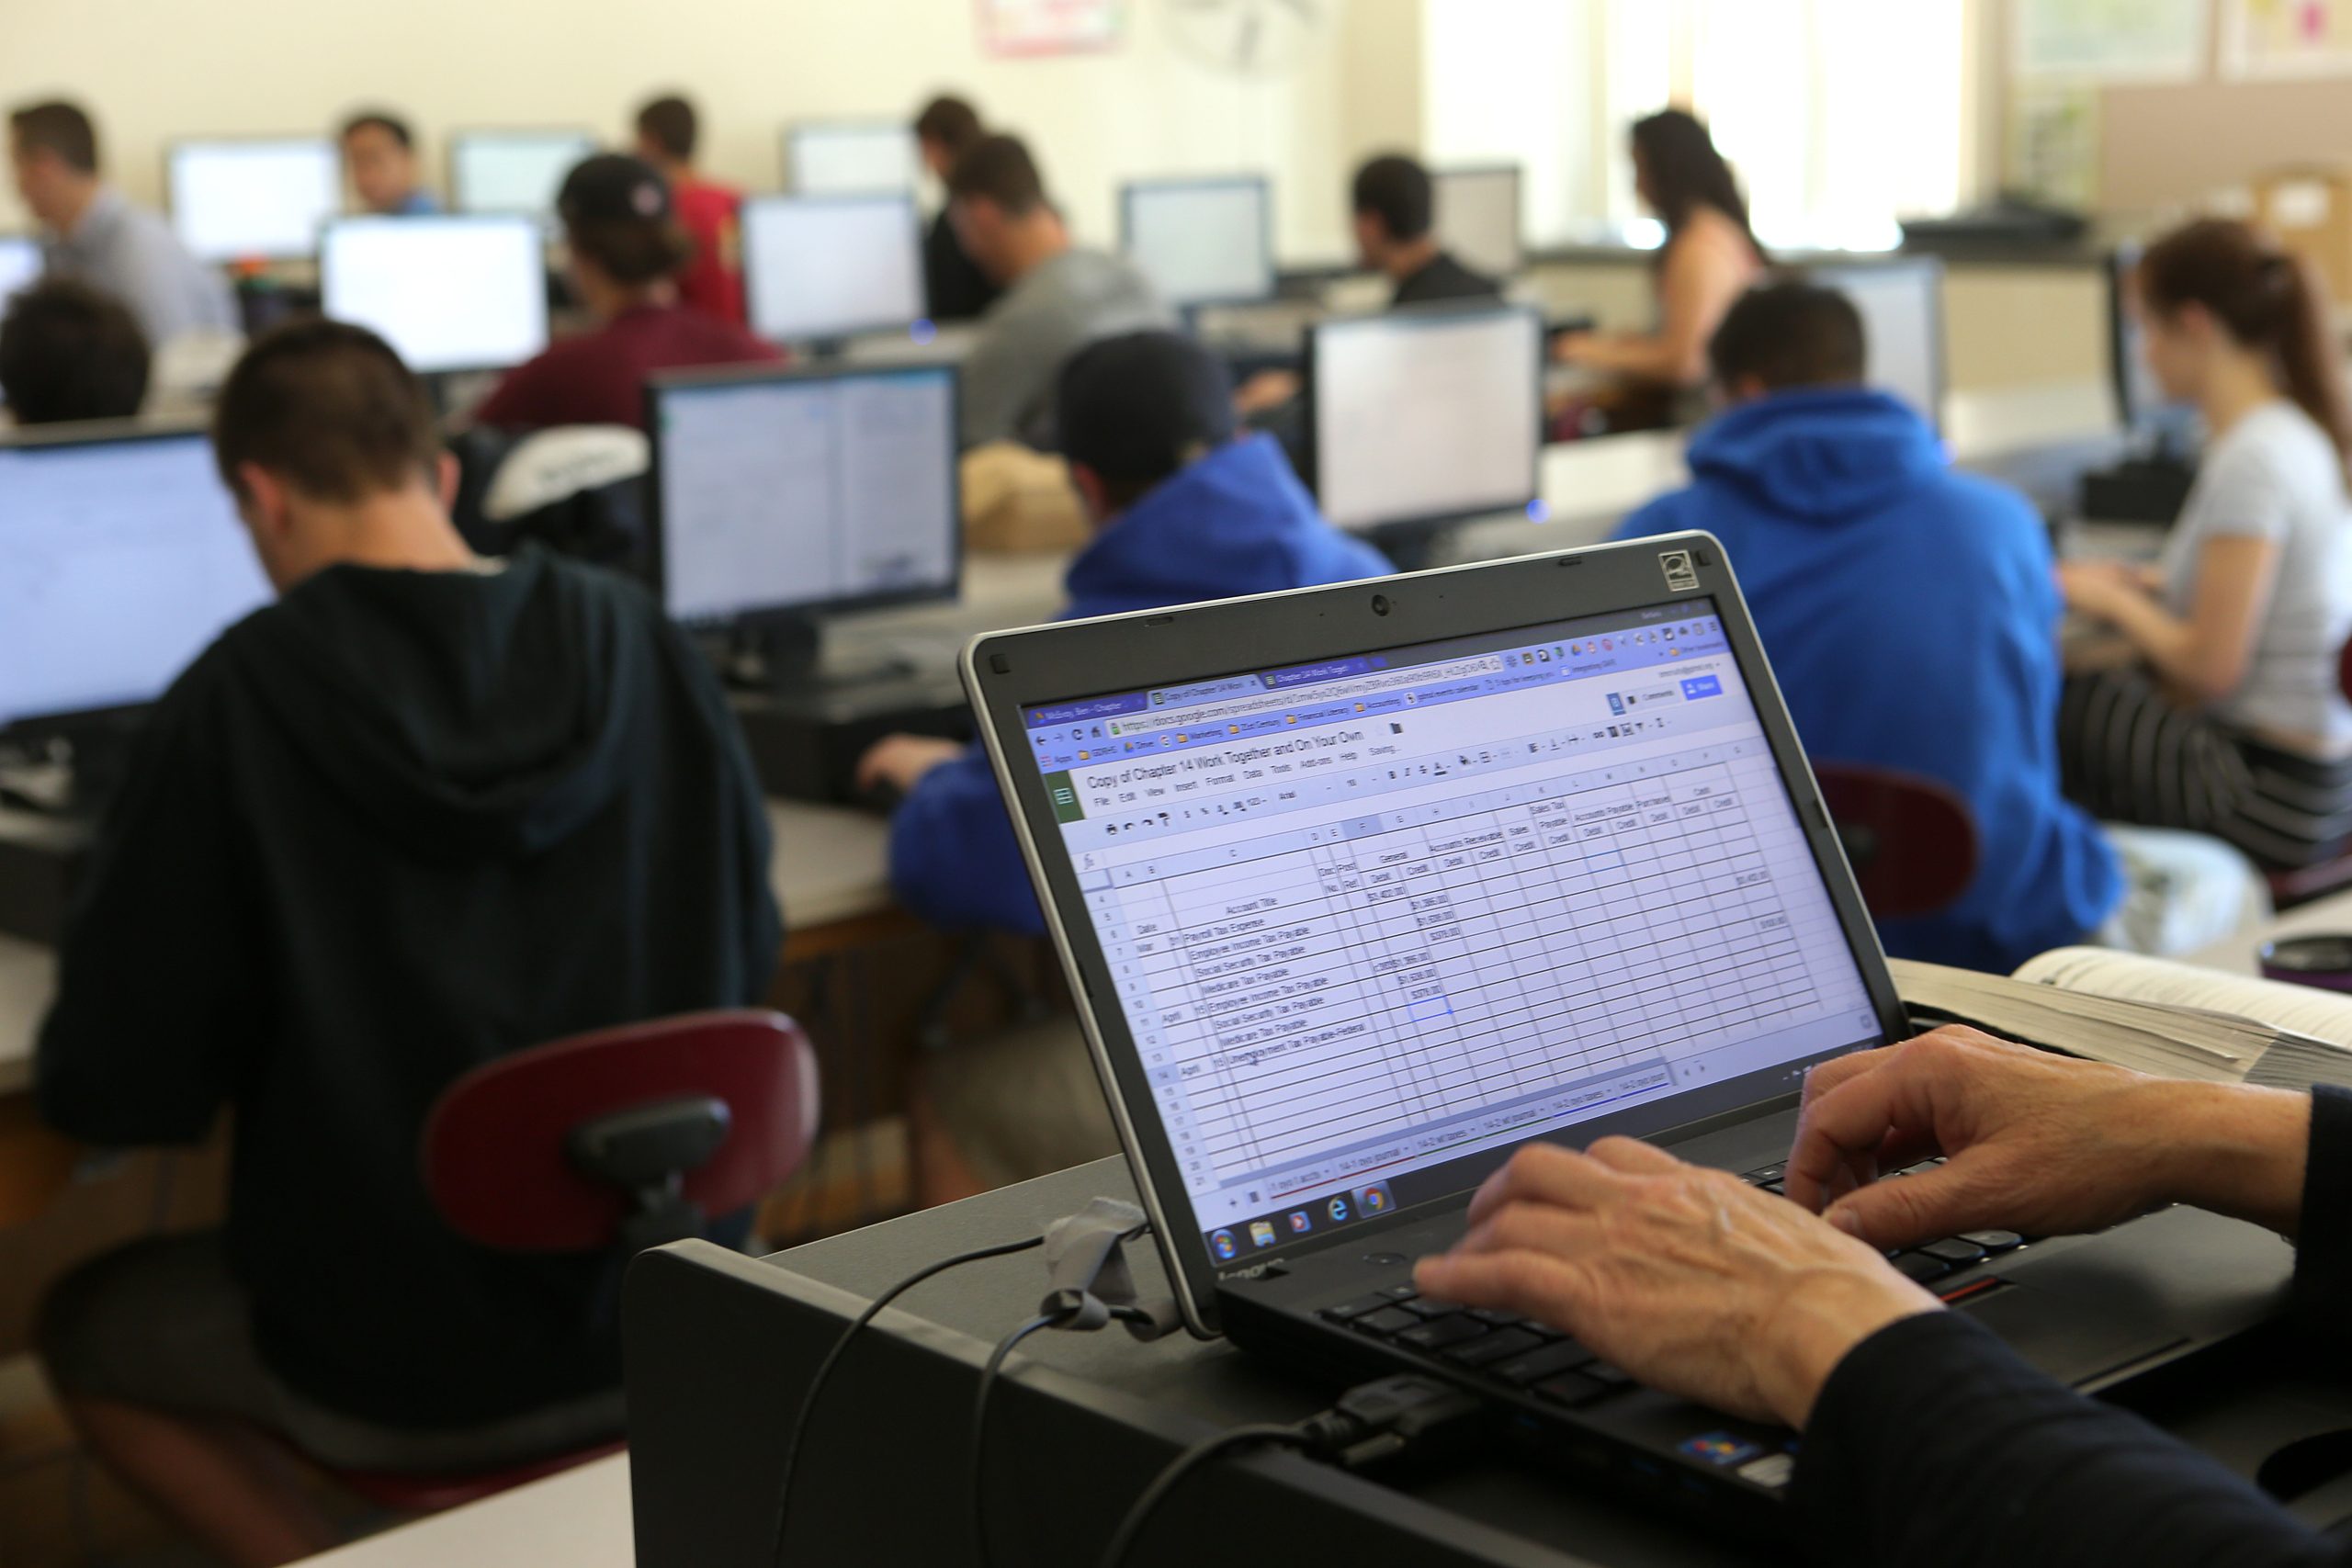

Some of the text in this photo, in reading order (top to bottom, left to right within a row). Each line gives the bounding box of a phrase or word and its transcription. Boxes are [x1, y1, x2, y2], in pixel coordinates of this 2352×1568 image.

[1087, 731, 1363, 788] Copy of Chapter 14 Work Together and On Your Own
[1093, 797, 1110, 806] File
[1118, 792, 1136, 802] Edit
[1146, 788, 1165, 796] View
[1175, 781, 1198, 792] Insert
[1205, 774, 1235, 784] Format
[1243, 770, 1263, 779] Data
[1270, 764, 1292, 773] Tools
[1301, 757, 1332, 768] Add-ons
[1340, 752, 1357, 761] Help
[1509, 827, 1529, 836] Sales
[1380, 852, 1408, 863] General
[1227, 898, 1278, 914] Account Title
[1136, 924, 1158, 934] Date
[1183, 919, 1264, 941] Payroll Tax Expense
[1190, 928, 1310, 960] Employee Income Tax Payable
[1196, 946, 1306, 977] Social Security Tax Payable
[1202, 968, 1289, 994] Medicare Tax Payable
[1208, 977, 1329, 1012] Employee Income Tax Payable
[1215, 998, 1324, 1030] Social Security Tax Payable
[1220, 1020, 1308, 1046] Medicare Tax Payable
[1286, 1040, 1302, 1048] Tax
